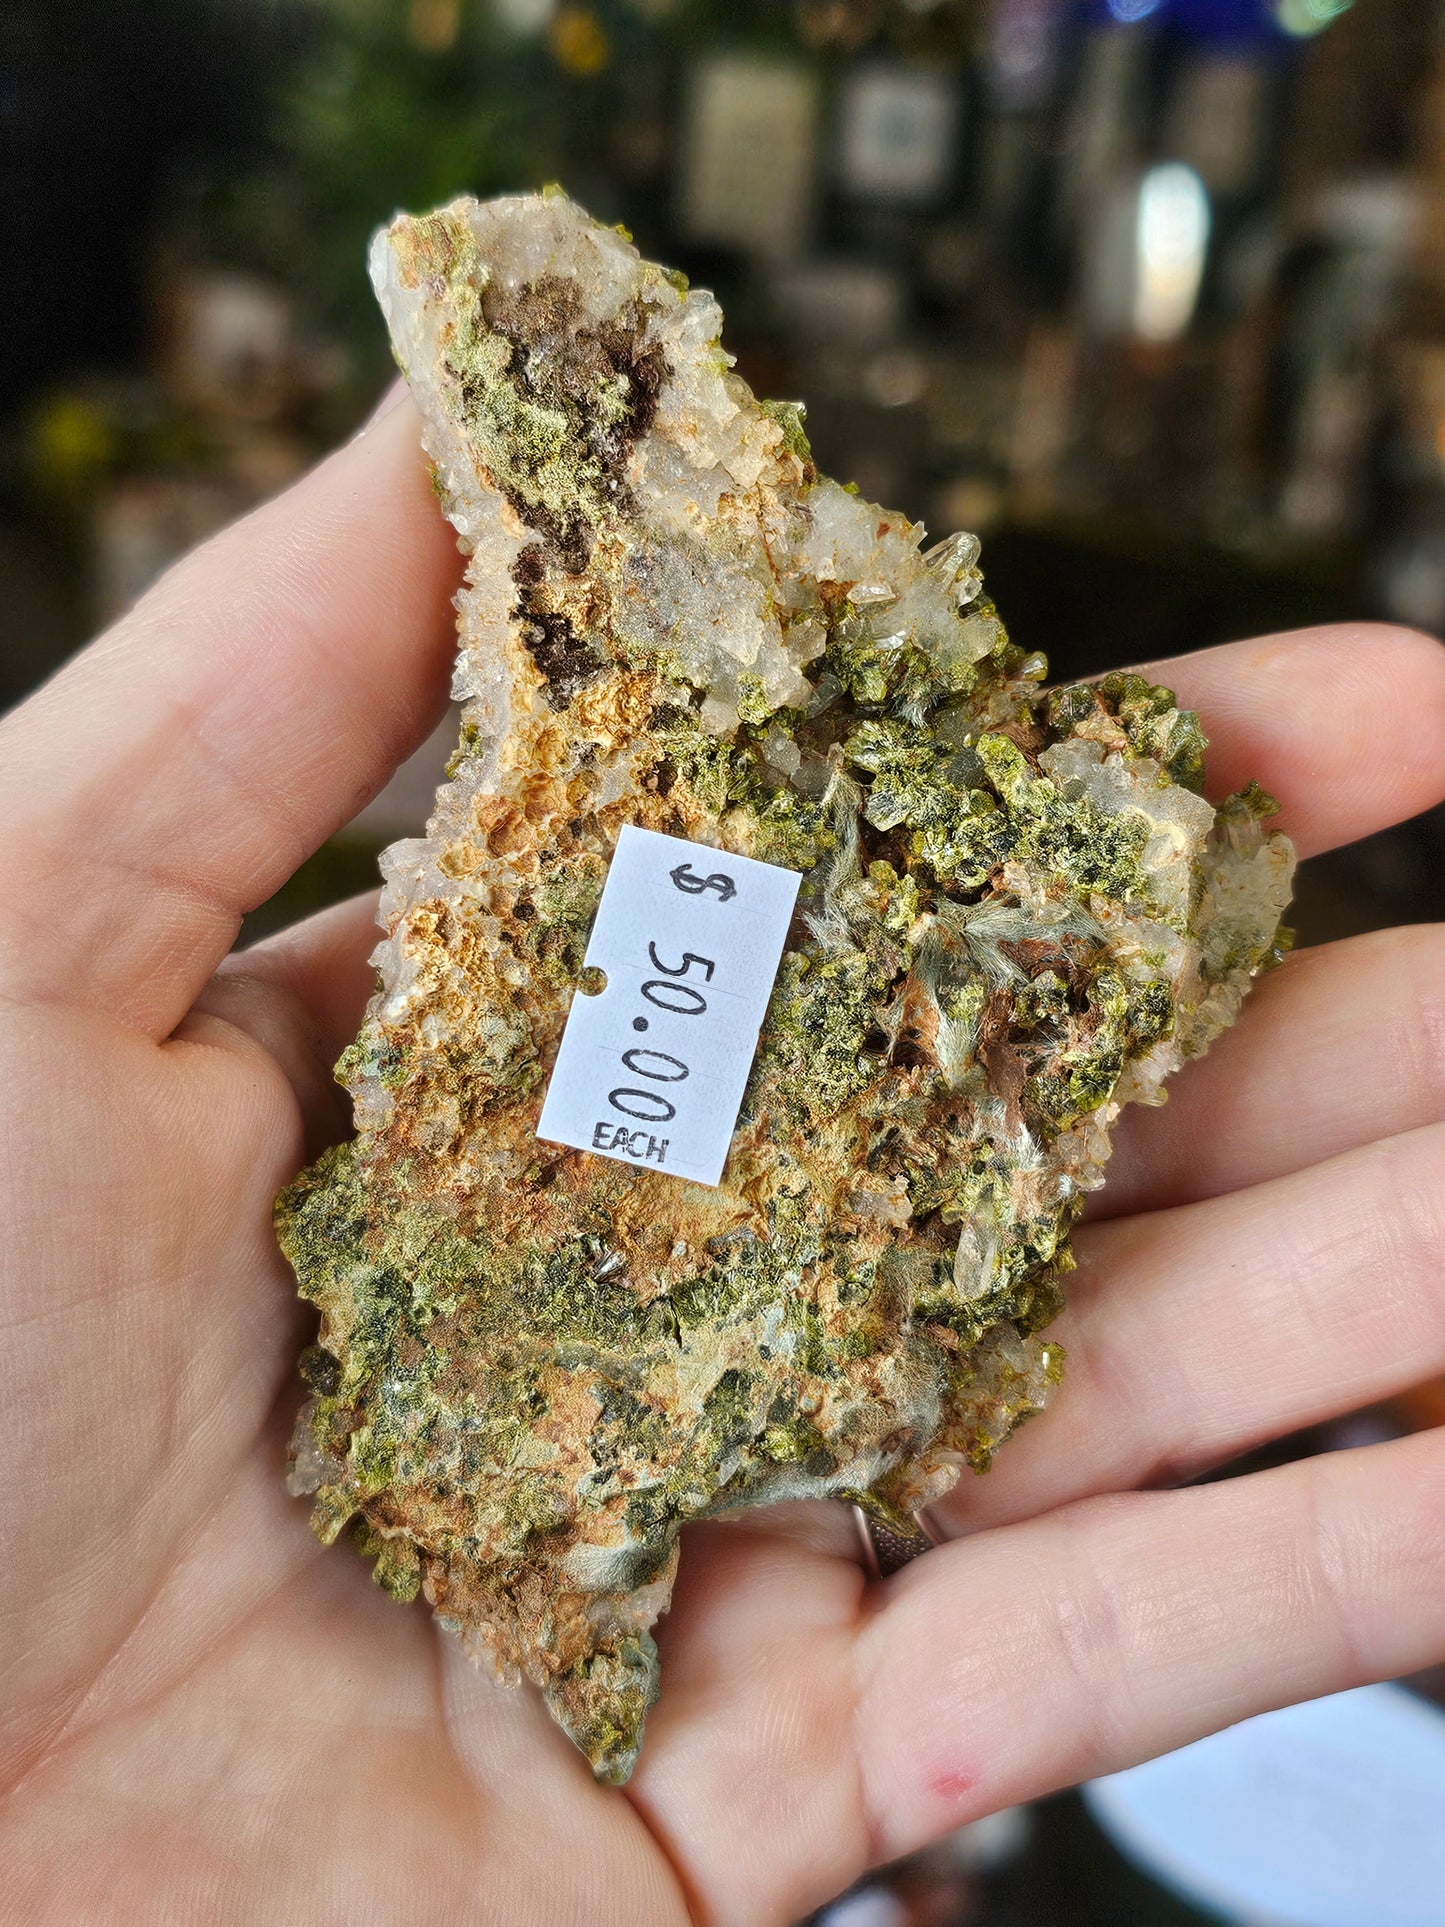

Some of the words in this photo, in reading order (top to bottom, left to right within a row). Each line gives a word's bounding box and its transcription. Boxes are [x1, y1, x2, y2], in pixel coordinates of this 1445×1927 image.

[669, 863, 738, 902] $
[607, 941, 716, 1122] 50.00
[592, 1121, 670, 1163] EACH
